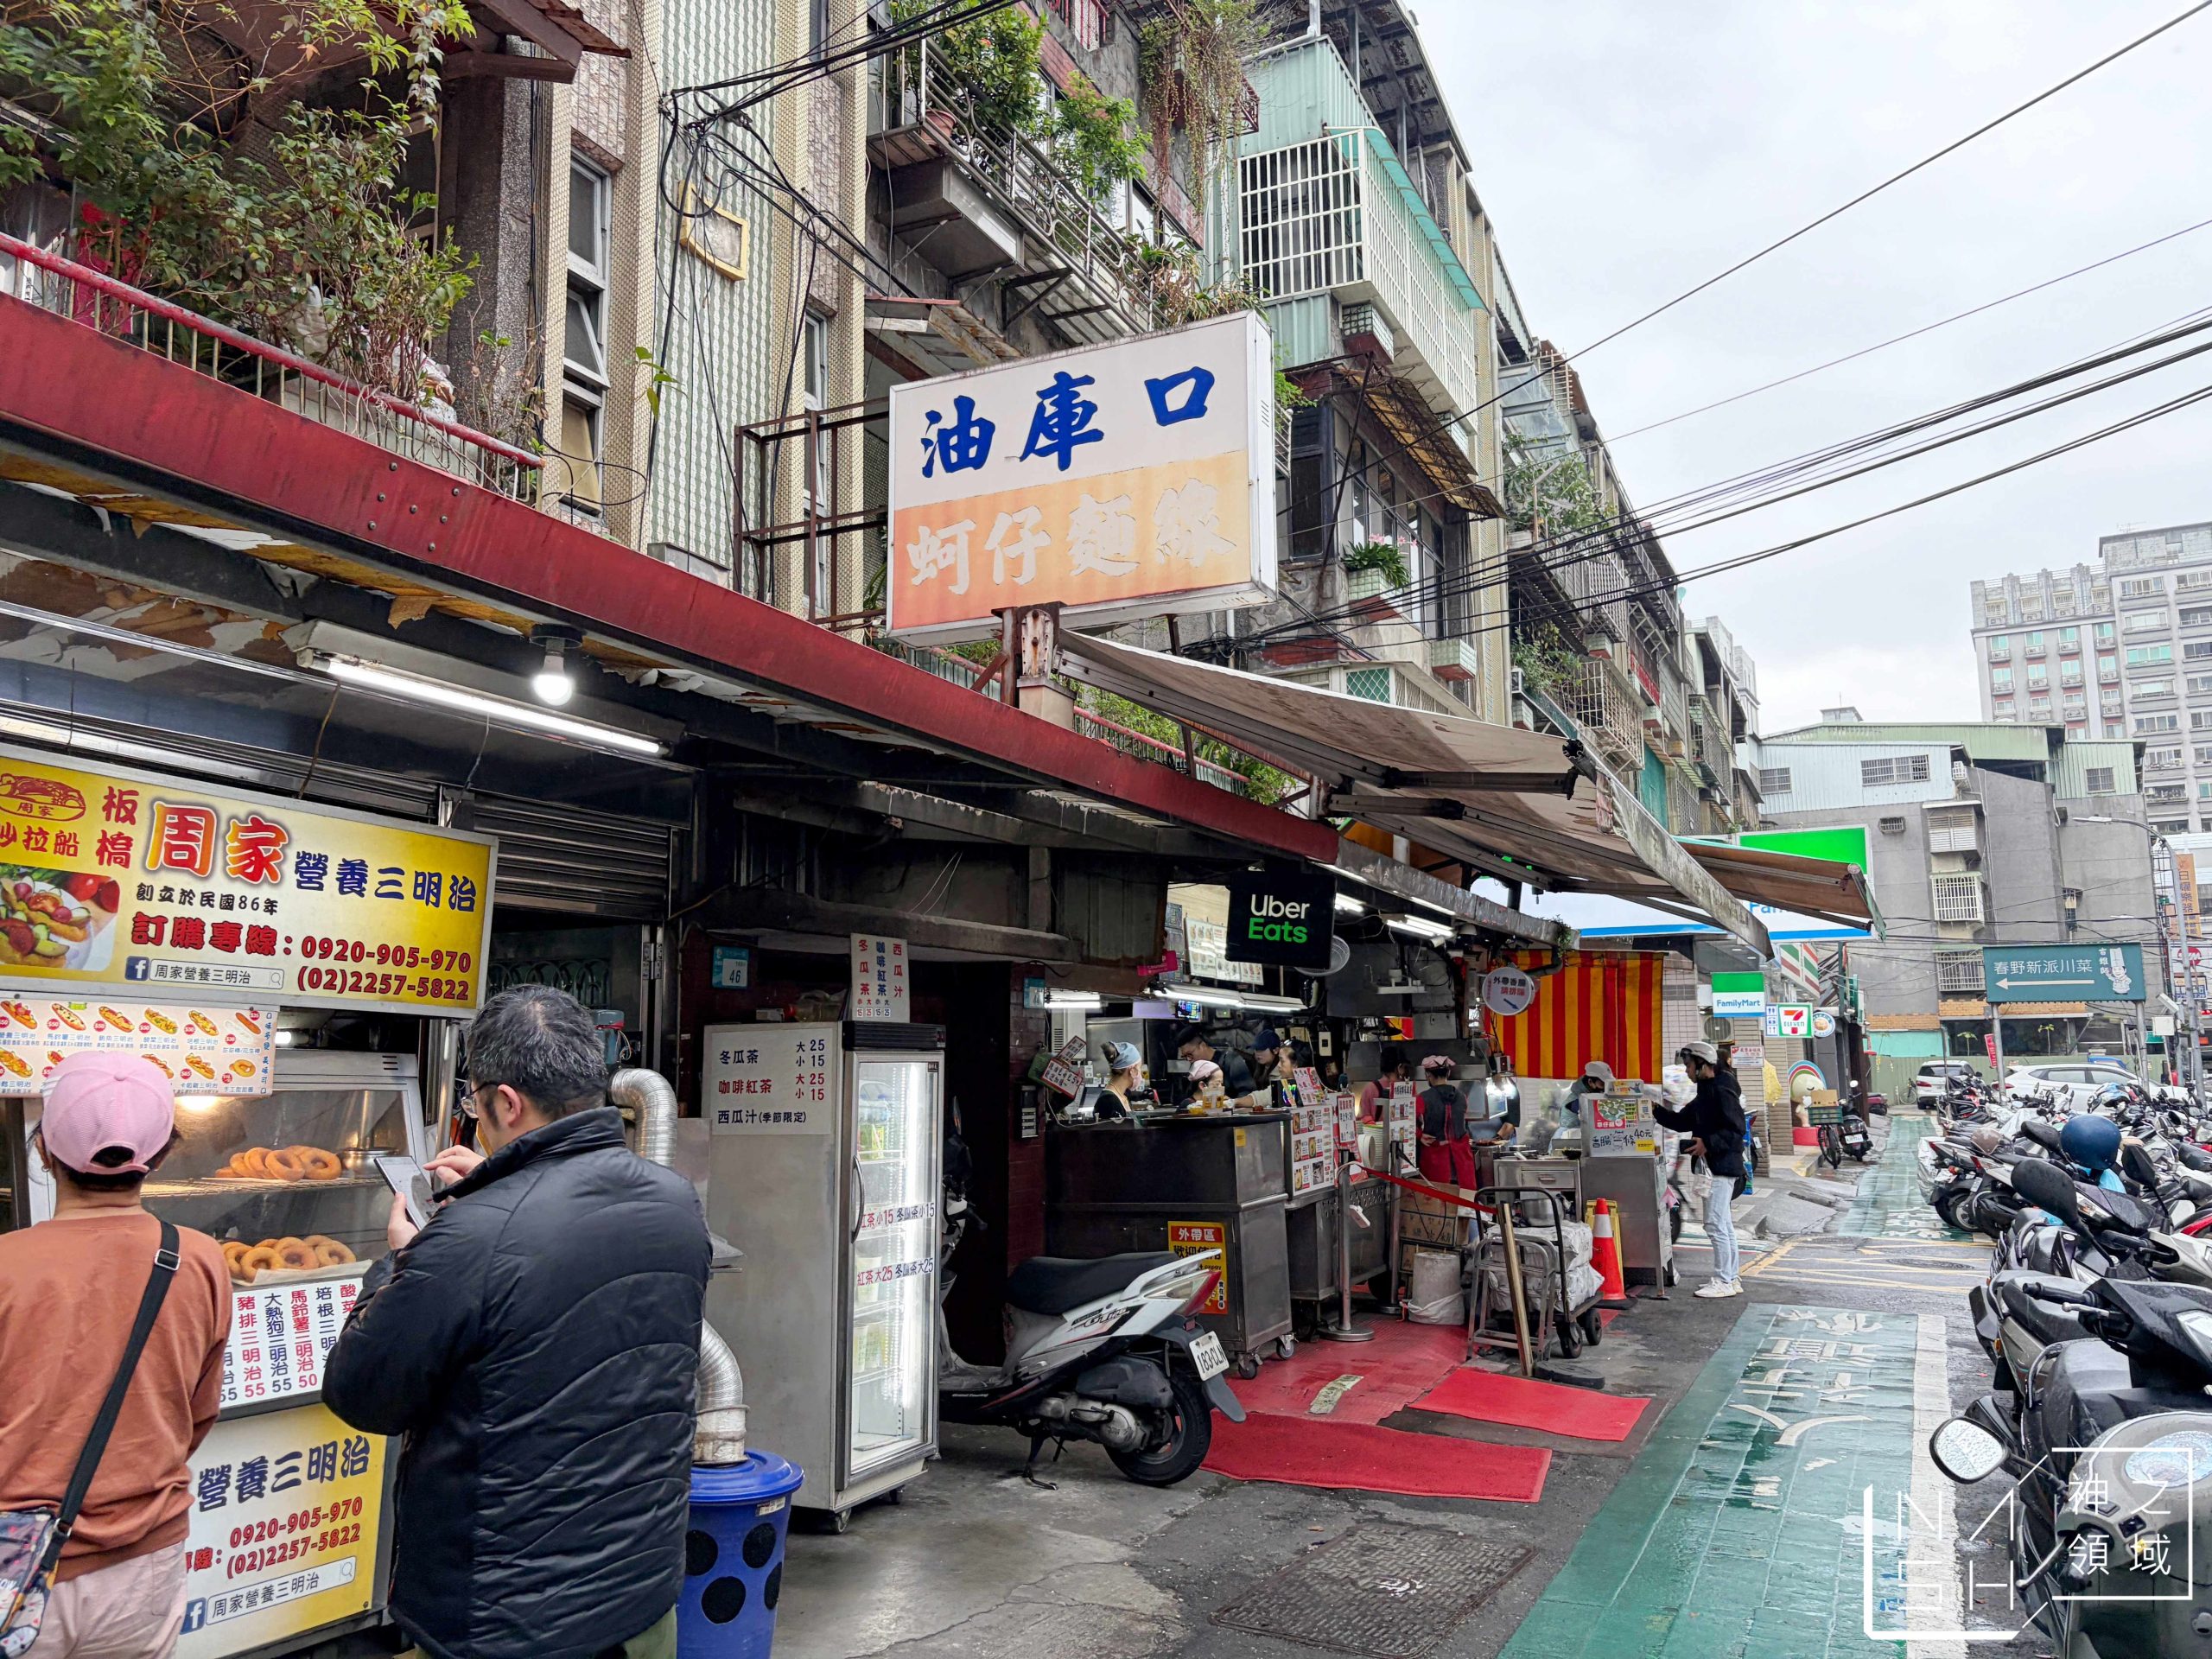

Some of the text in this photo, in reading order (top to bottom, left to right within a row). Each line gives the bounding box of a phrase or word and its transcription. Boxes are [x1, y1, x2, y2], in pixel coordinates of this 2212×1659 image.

[921, 366, 1215, 478] 油庫口
[906, 478, 1236, 595] 蚵仔麵線
[96, 785, 139, 869] 板橋
[145, 800, 290, 884] 周家
[295, 850, 477, 912] 營養三明治
[136, 882, 278, 916] 創立於民國86年
[1250, 893, 1311, 919] Uber
[1249, 917, 1308, 944] Eats
[302, 935, 471, 974] 0920-905-970
[858, 939, 869, 995] 冬瓜茶
[893, 943, 903, 998] 西瓜汁
[1993, 958, 2093, 975] 春野新派川菜
[155, 964, 251, 984] 周家營養三明治
[297, 965, 469, 1001] (02)2257-5822
[729, 969, 741, 983] 46
[1716, 999, 1761, 1008] FamilyMart
[719, 1049, 759, 1065] 冬瓜茶
[796, 1039, 824, 1052] 大 25
[796, 1054, 824, 1067] 小 15
[718, 1078, 772, 1094] 咖啡紅茶
[795, 1088, 824, 1101] 小 15
[796, 1072, 824, 1084] 大 25
[1179, 1228, 1216, 1242] 外帶區
[237, 1295, 262, 1382] 豬排三明治
[264, 1293, 289, 1377] 大熱狗三明治
[290, 1289, 315, 1373] 馬鈴薯三明治
[315, 1287, 338, 1369] 培根三明
[245, 1382, 265, 1398] 55
[272, 1377, 292, 1393] 55
[298, 1373, 318, 1389] 50
[198, 1434, 371, 1512] 營養三明治
[229, 1496, 363, 1548] 0920-905-970
[226, 1522, 361, 1580] (02)2257-5822
[212, 1572, 320, 1619] 周家營養三明治
